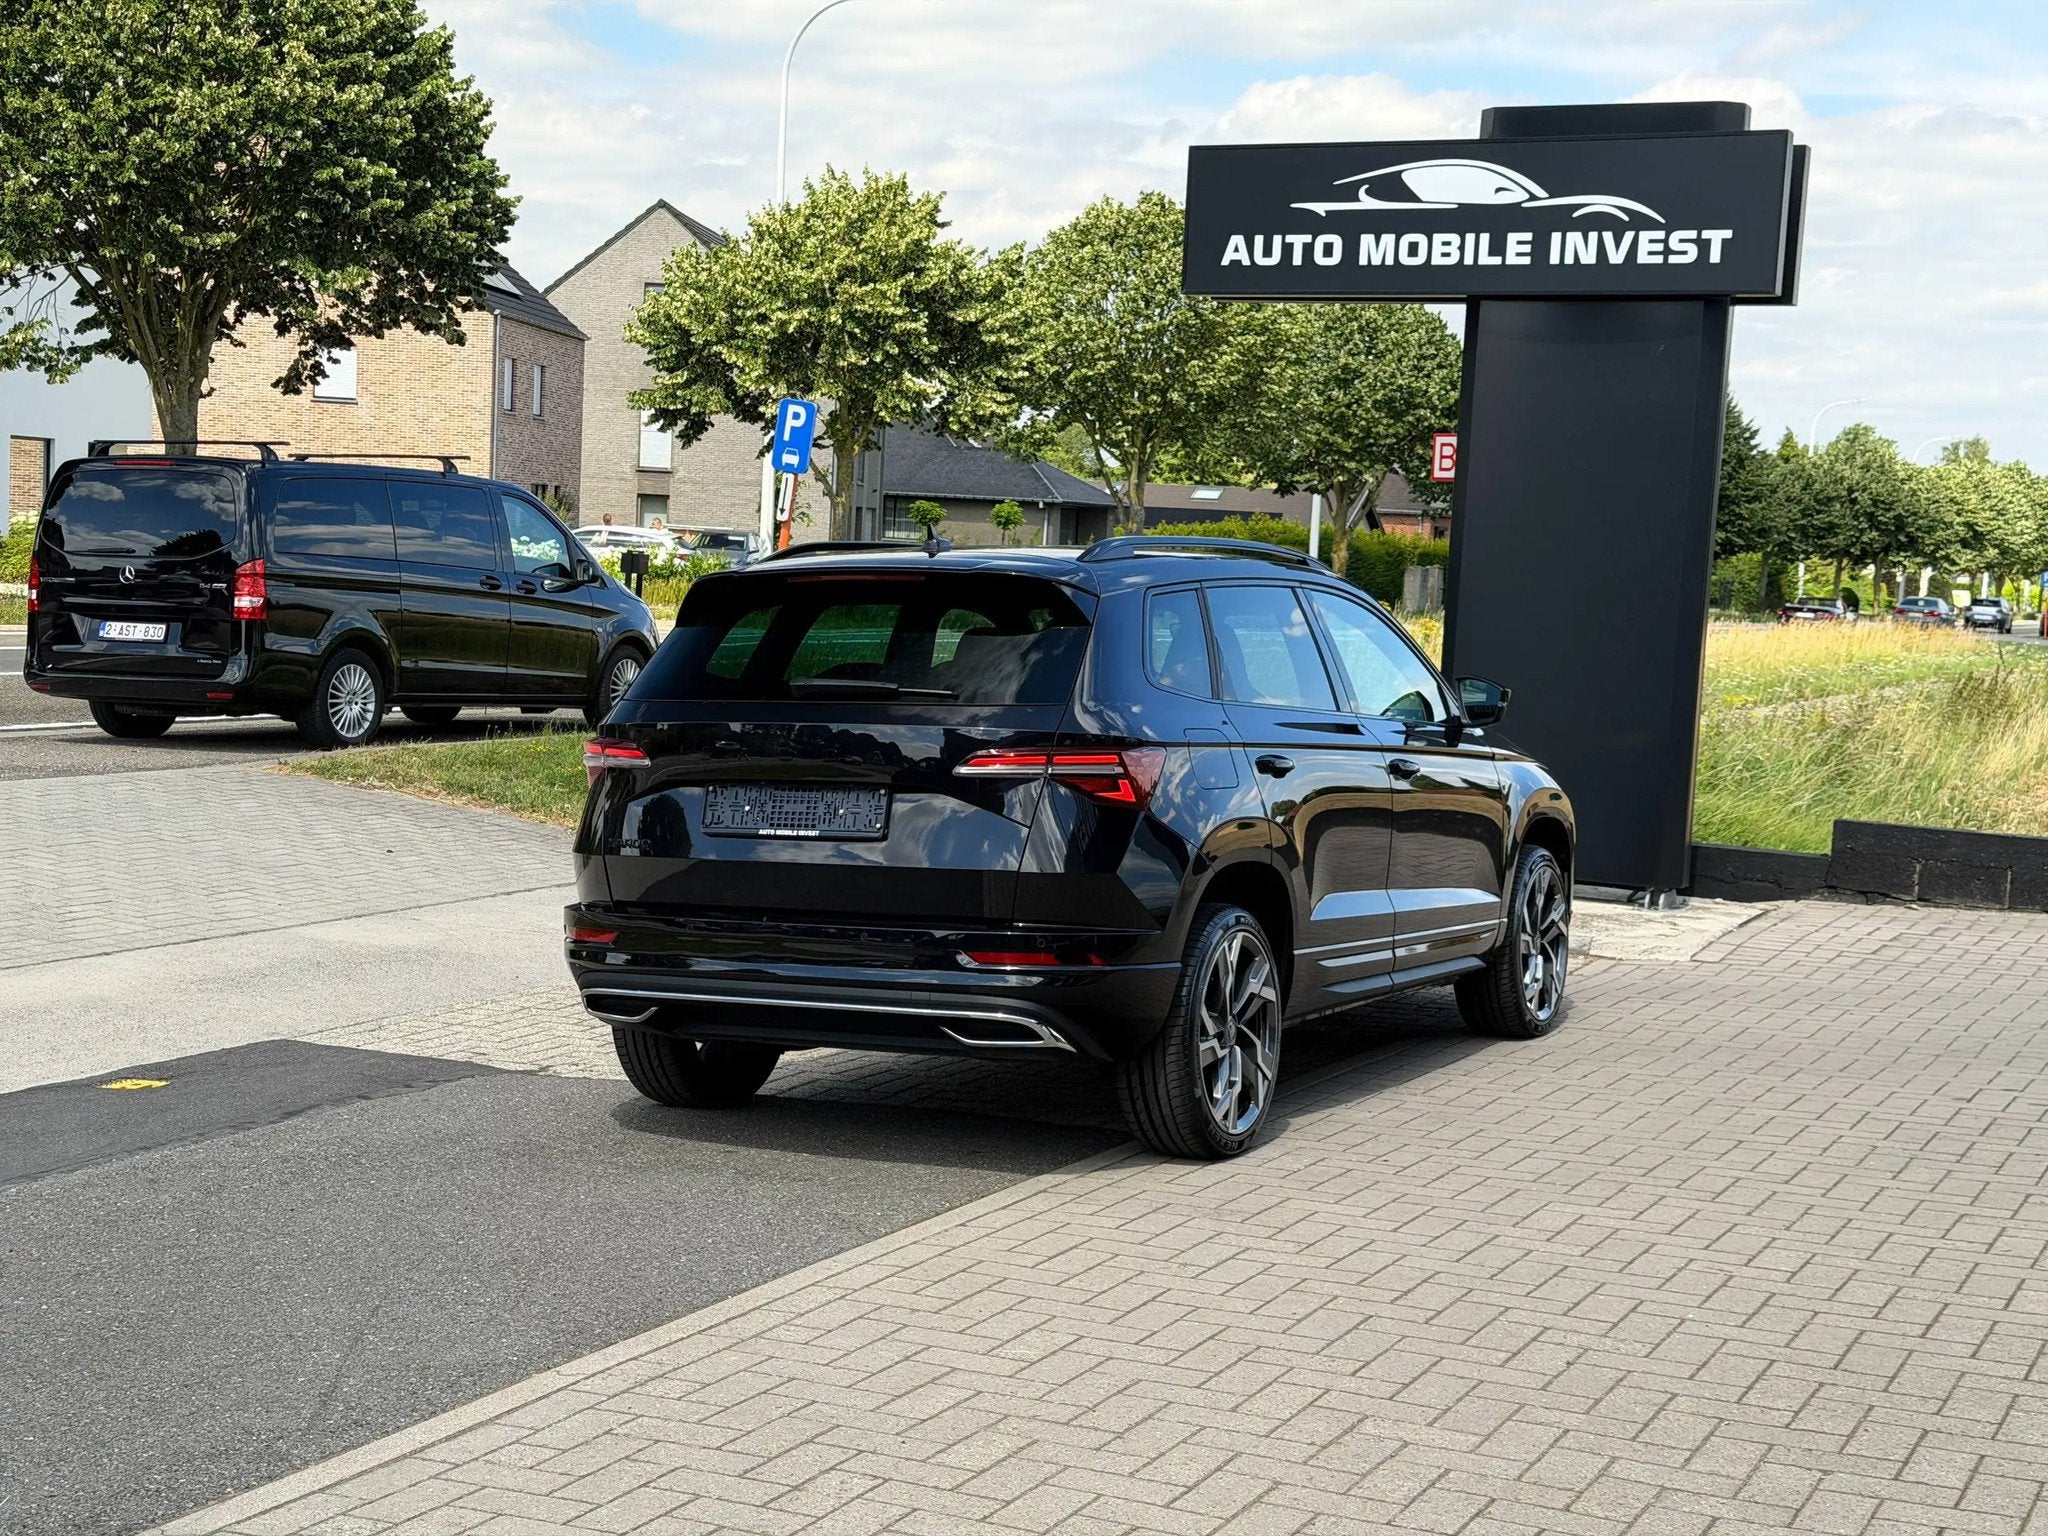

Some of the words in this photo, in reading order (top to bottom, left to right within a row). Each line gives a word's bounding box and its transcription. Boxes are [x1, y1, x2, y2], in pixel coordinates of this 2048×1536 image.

[1220, 234, 1344, 267] AUTO
[1358, 232, 1533, 266] MOBILE
[1548, 229, 1734, 266] INVEST
[783, 404, 807, 442] P
[1439, 442, 1457, 471] B
